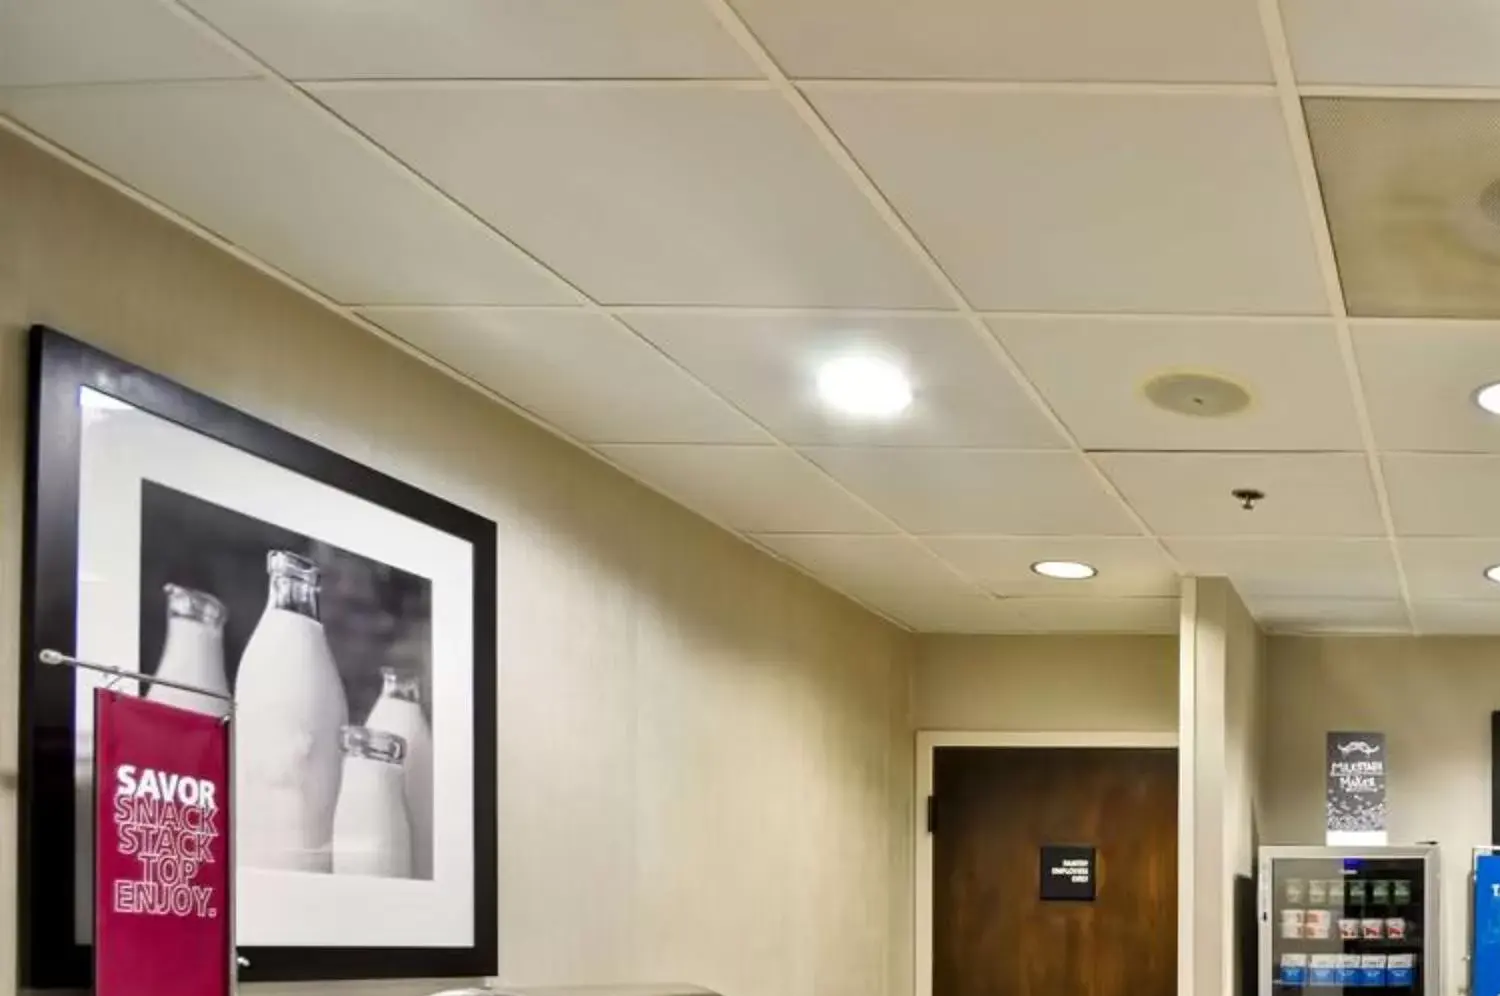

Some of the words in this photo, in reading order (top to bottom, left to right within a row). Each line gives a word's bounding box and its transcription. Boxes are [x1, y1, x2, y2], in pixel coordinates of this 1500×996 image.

[116, 764, 216, 809] SAVOR
[114, 795, 218, 836] SNACK
[118, 822, 216, 863] STACK
[137, 853, 199, 886] TOP
[114, 879, 218, 918] ENJOY.
